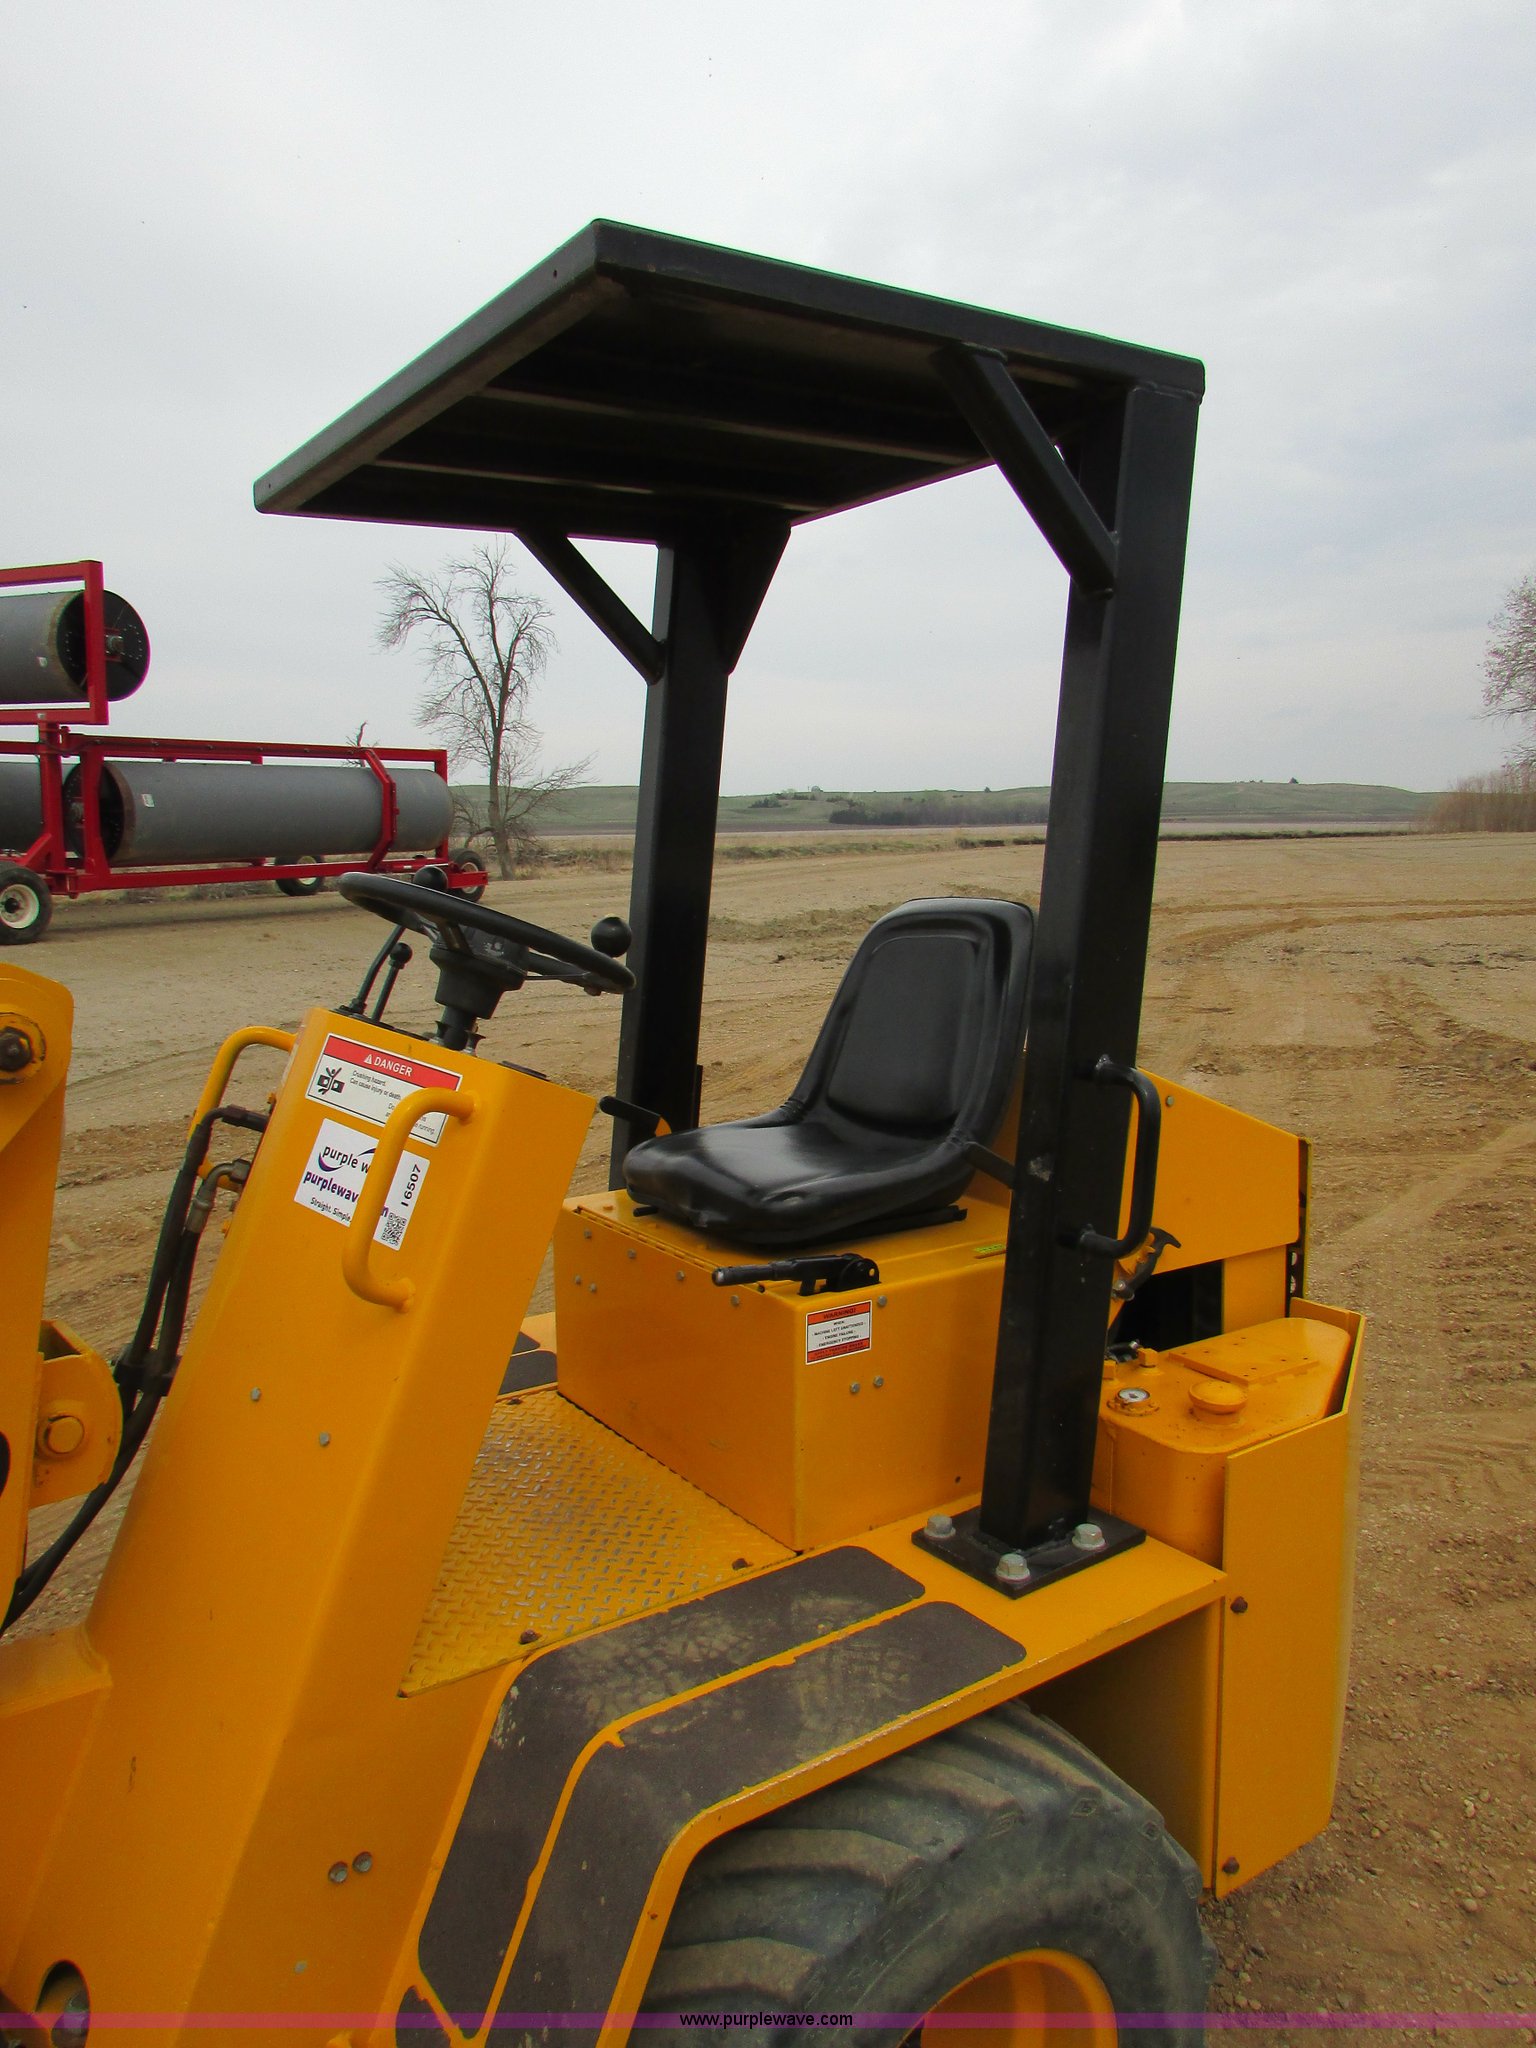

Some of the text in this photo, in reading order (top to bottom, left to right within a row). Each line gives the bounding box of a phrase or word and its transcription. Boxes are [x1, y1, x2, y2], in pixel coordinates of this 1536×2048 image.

[374, 1056, 413, 1077] DANGER
[350, 1077, 358, 1086] Can
[358, 1081, 370, 1090] cause
[370, 1084, 384, 1095] injury
[352, 1070, 371, 1083] Crushing
[322, 1146, 359, 1169] purple
